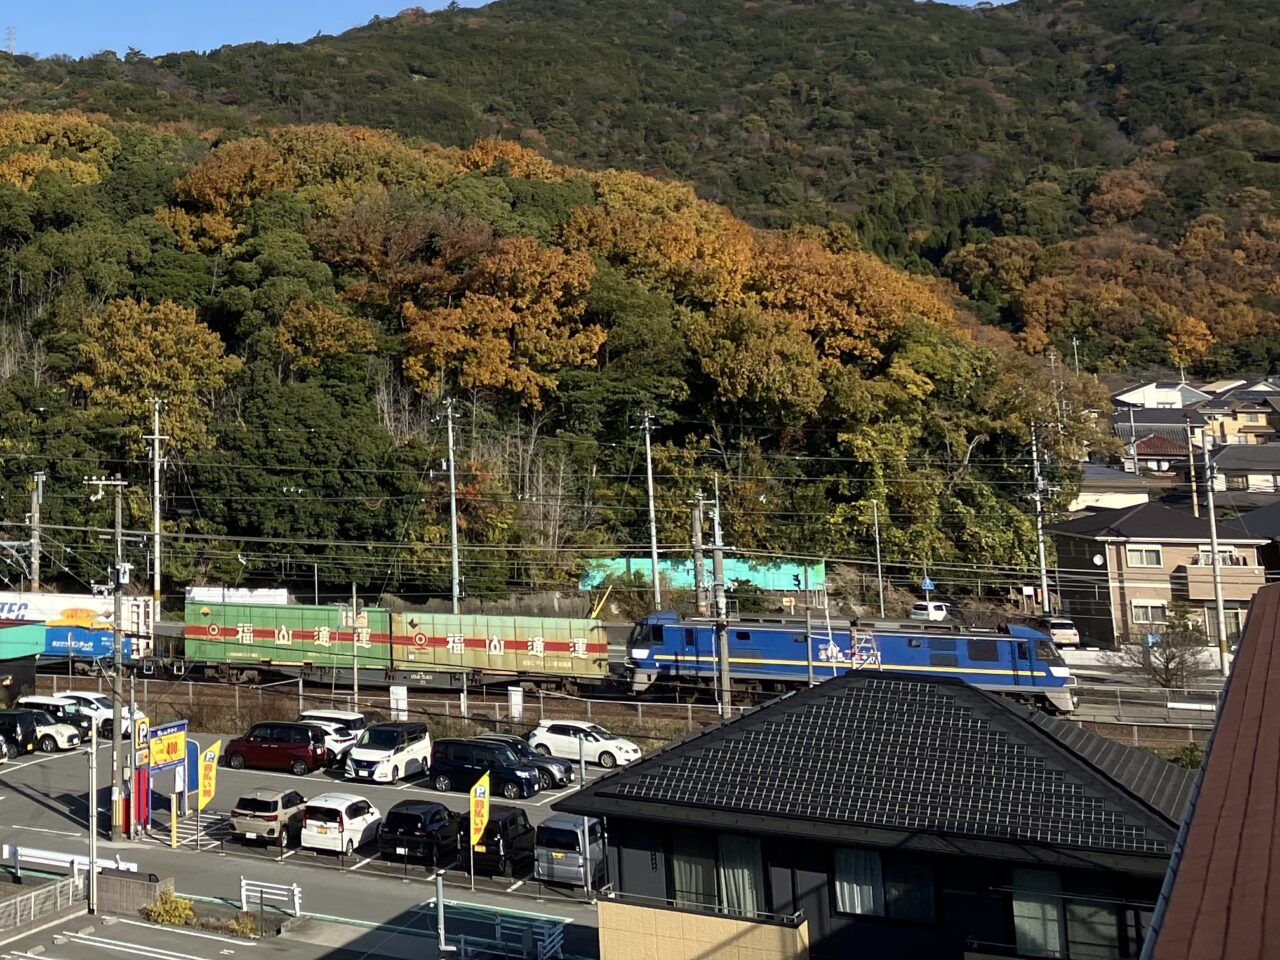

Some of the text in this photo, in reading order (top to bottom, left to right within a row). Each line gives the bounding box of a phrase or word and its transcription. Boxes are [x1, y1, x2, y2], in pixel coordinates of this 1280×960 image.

[236, 623, 371, 648] 福山通運
[446, 634, 588, 659] 福山通運
